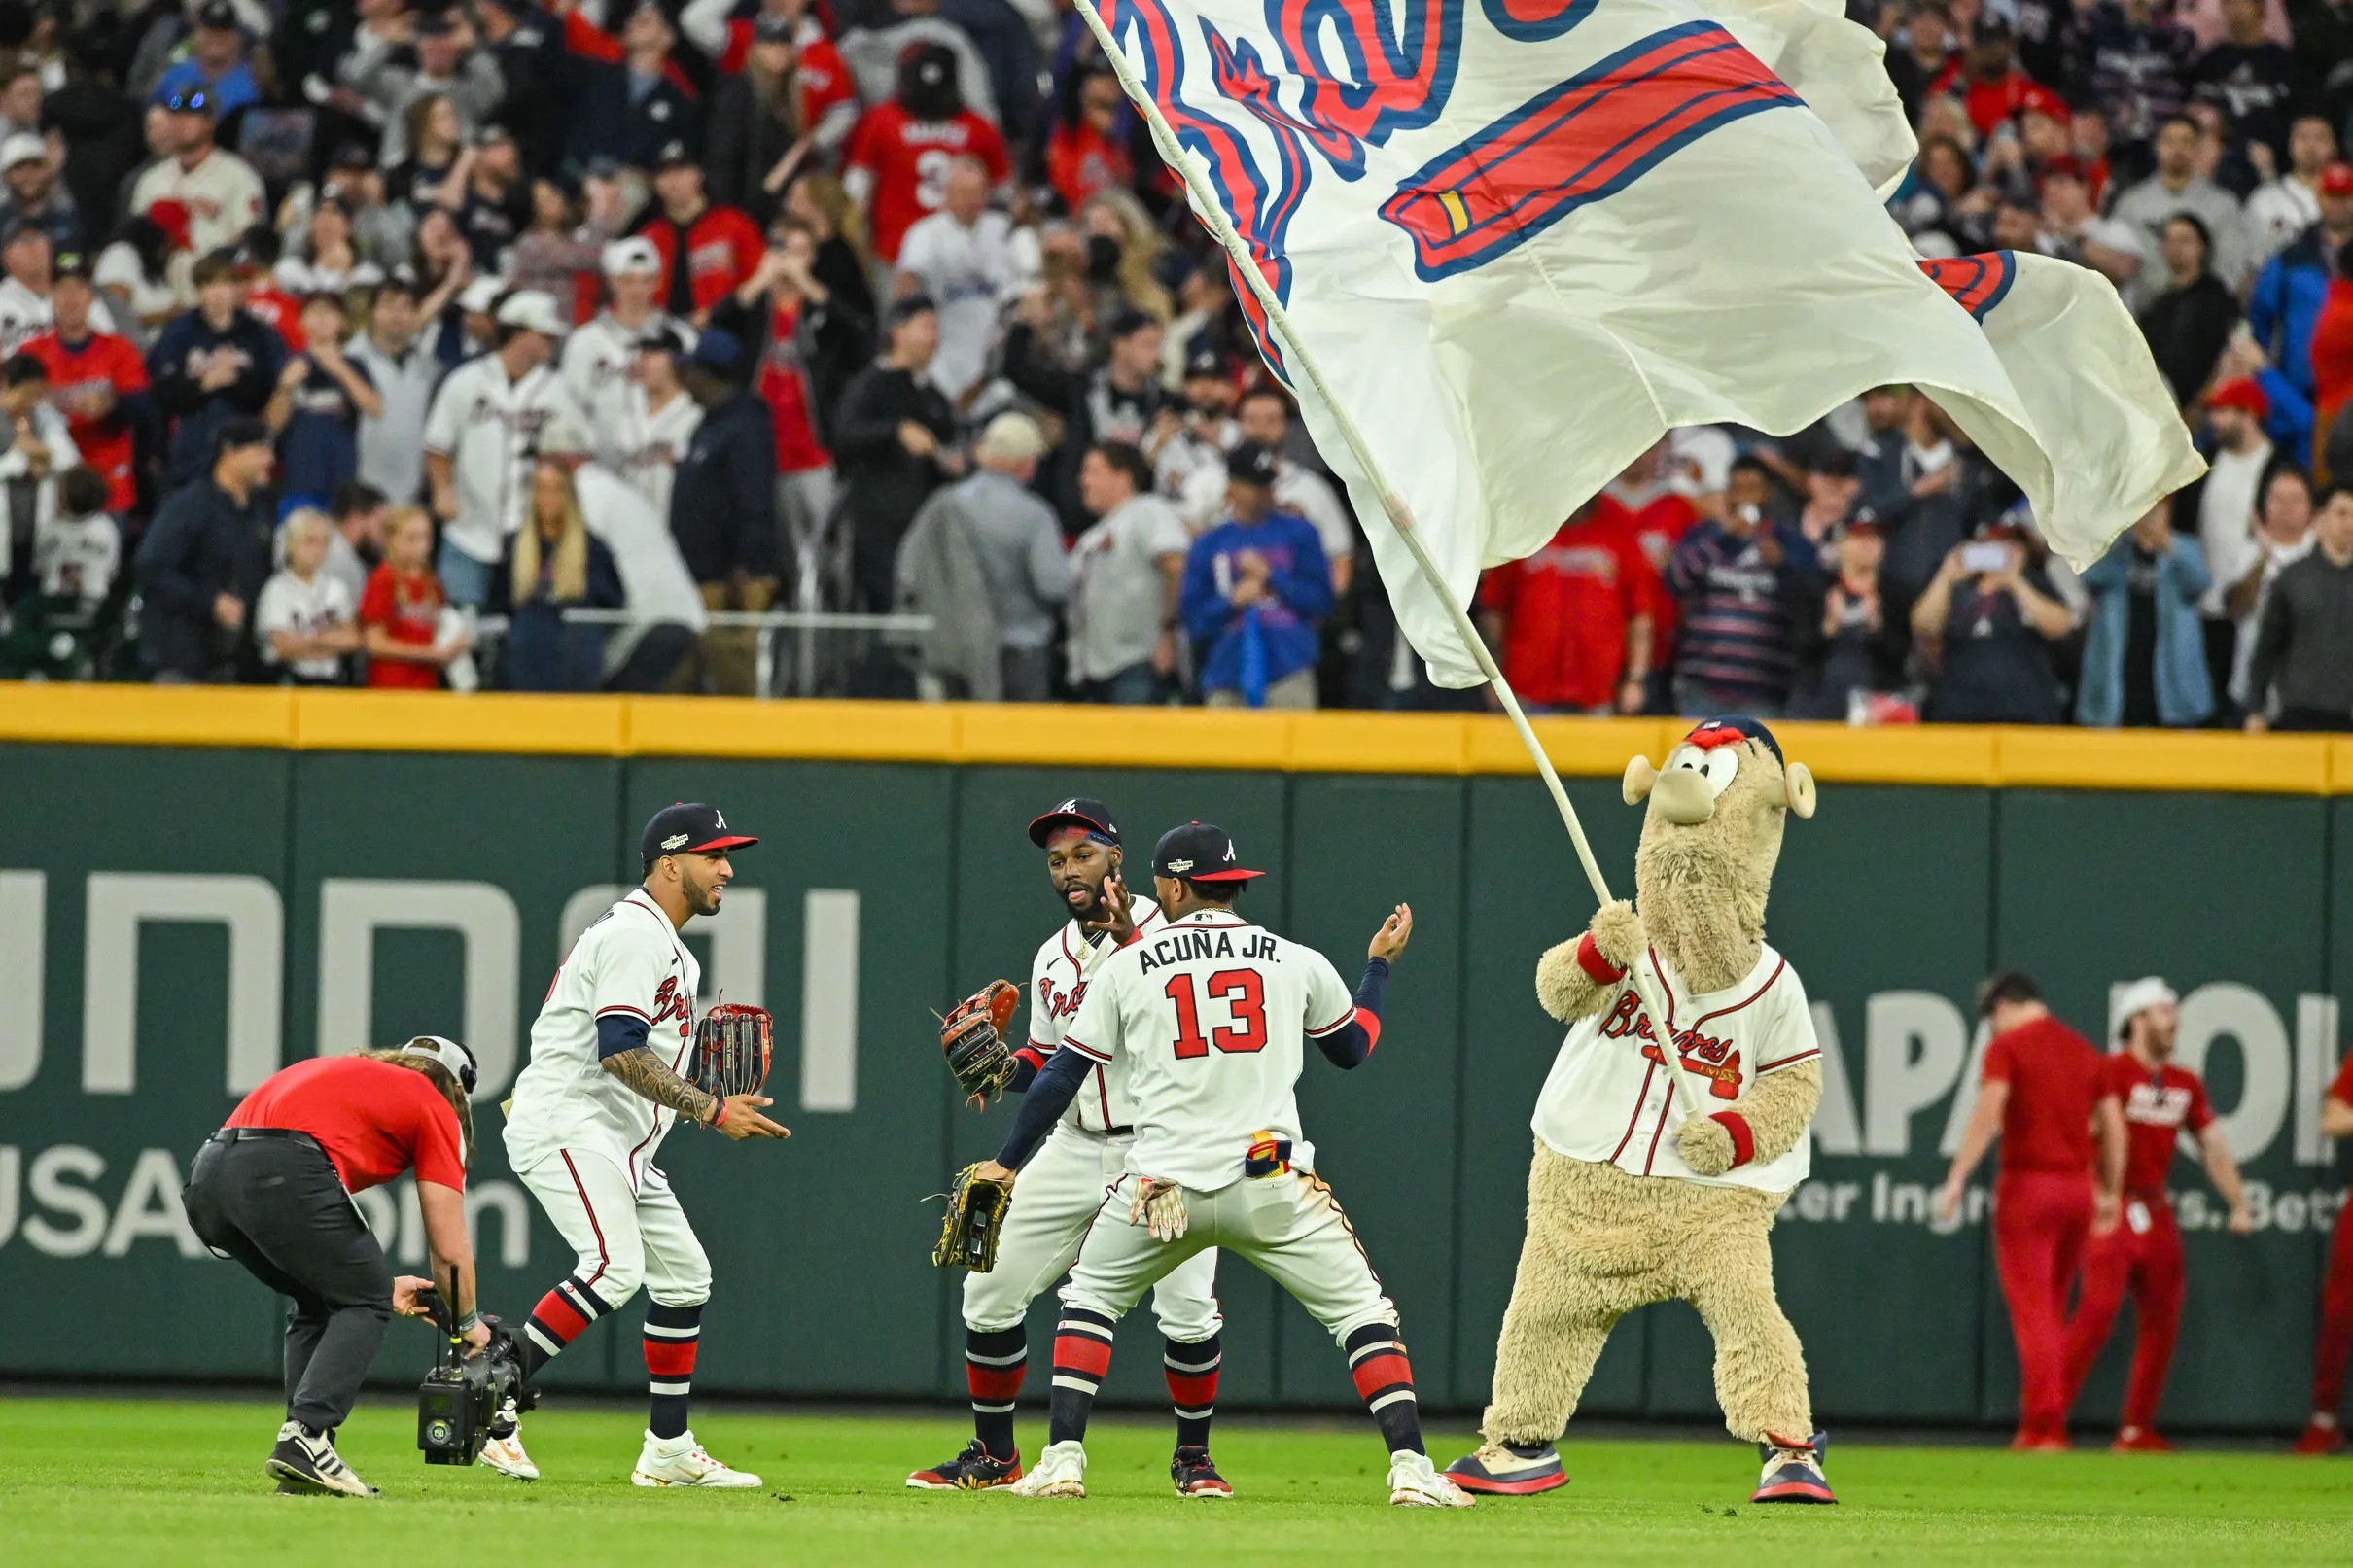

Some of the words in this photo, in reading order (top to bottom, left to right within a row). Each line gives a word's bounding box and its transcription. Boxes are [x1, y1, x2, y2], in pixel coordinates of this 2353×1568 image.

[1139, 928, 1235, 976] ACUÑA
[1242, 934, 1281, 963] JR.
[1164, 967, 1268, 1060] 13
